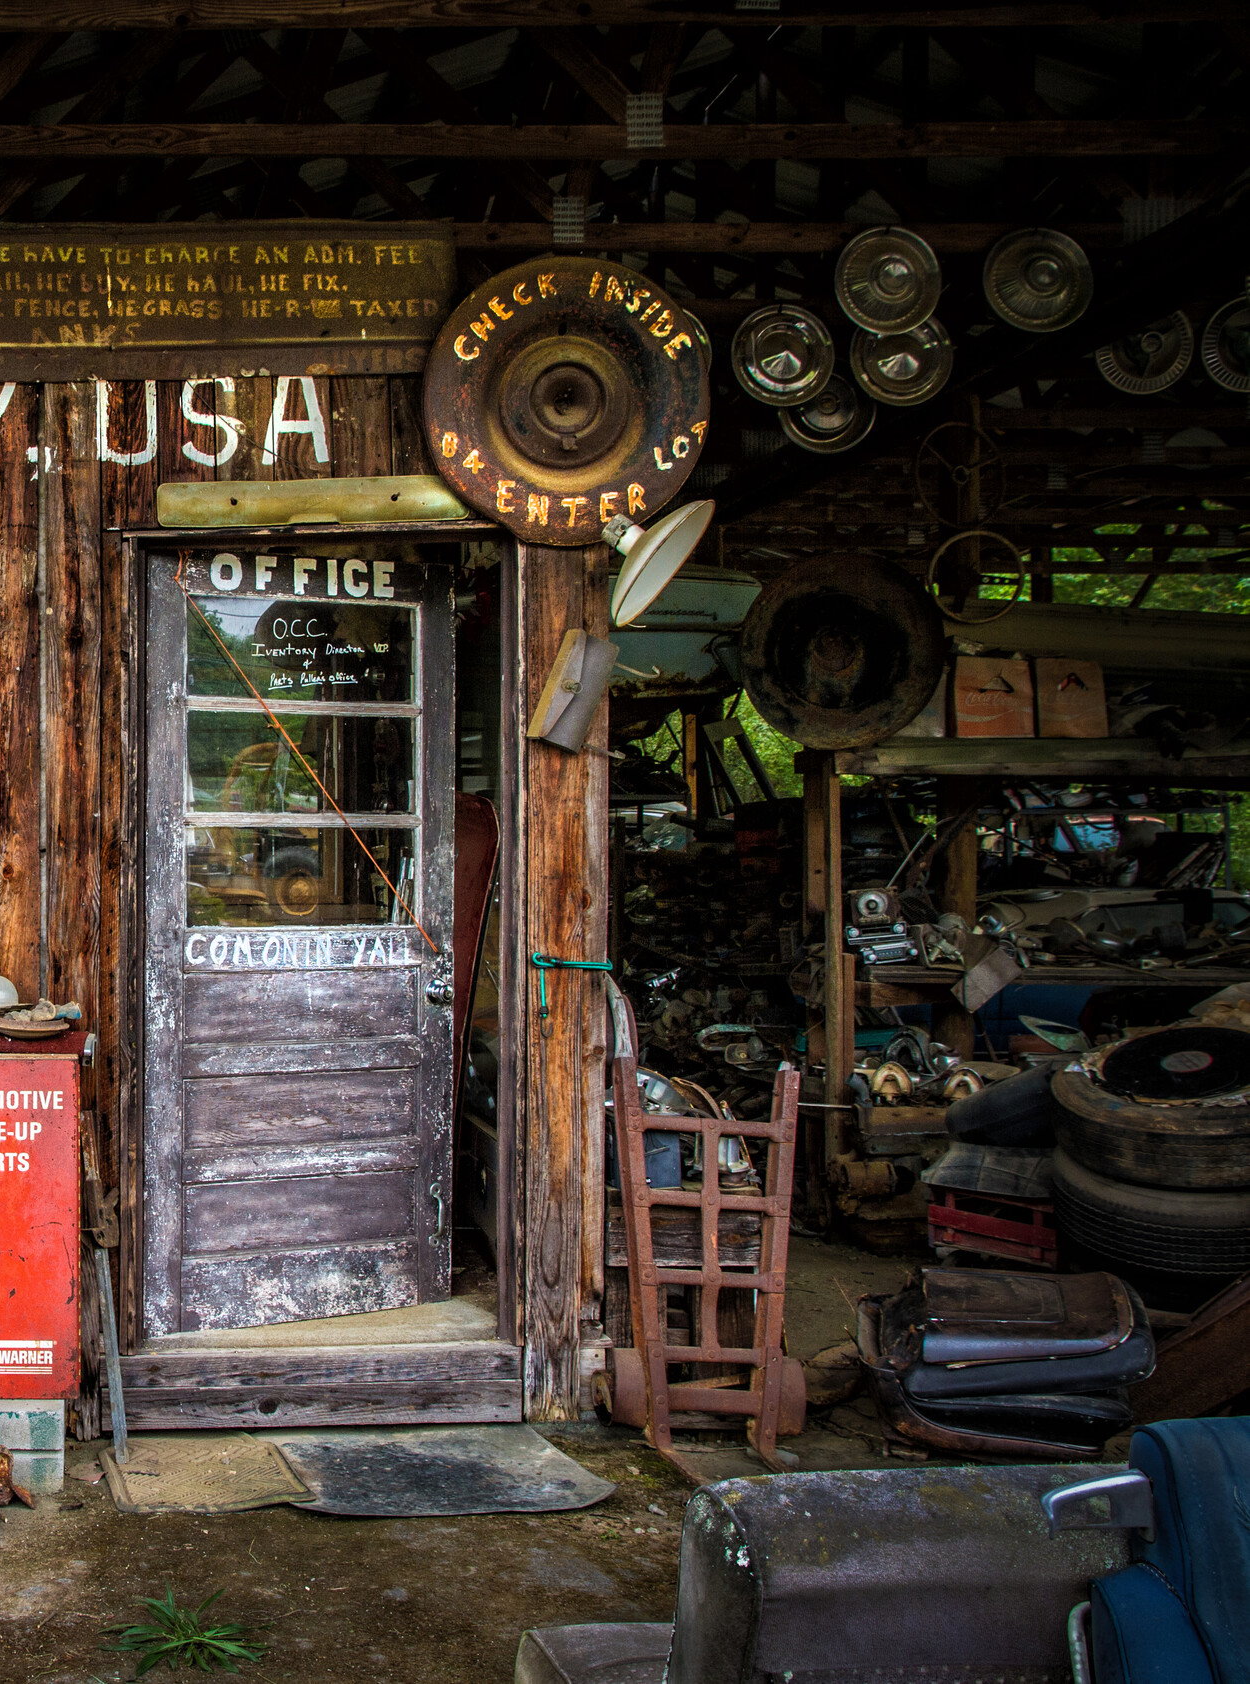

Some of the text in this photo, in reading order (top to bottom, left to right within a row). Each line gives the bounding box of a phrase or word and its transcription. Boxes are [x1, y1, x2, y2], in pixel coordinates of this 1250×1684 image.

[255, 246, 290, 265] AN
[374, 246, 424, 265] FEE
[38, 271, 72, 292] WE
[145, 273, 175, 292] WE
[260, 274, 290, 292] WE
[350, 299, 440, 318] TAXED
[453, 271, 693, 361] CHECK INSIDE
[96, 374, 330, 468] USA
[441, 420, 708, 528] B4 ENTER LOT
[209, 552, 396, 599] OFFICE
[273, 617, 329, 640] O.C.C.
[185, 932, 253, 967] COM
